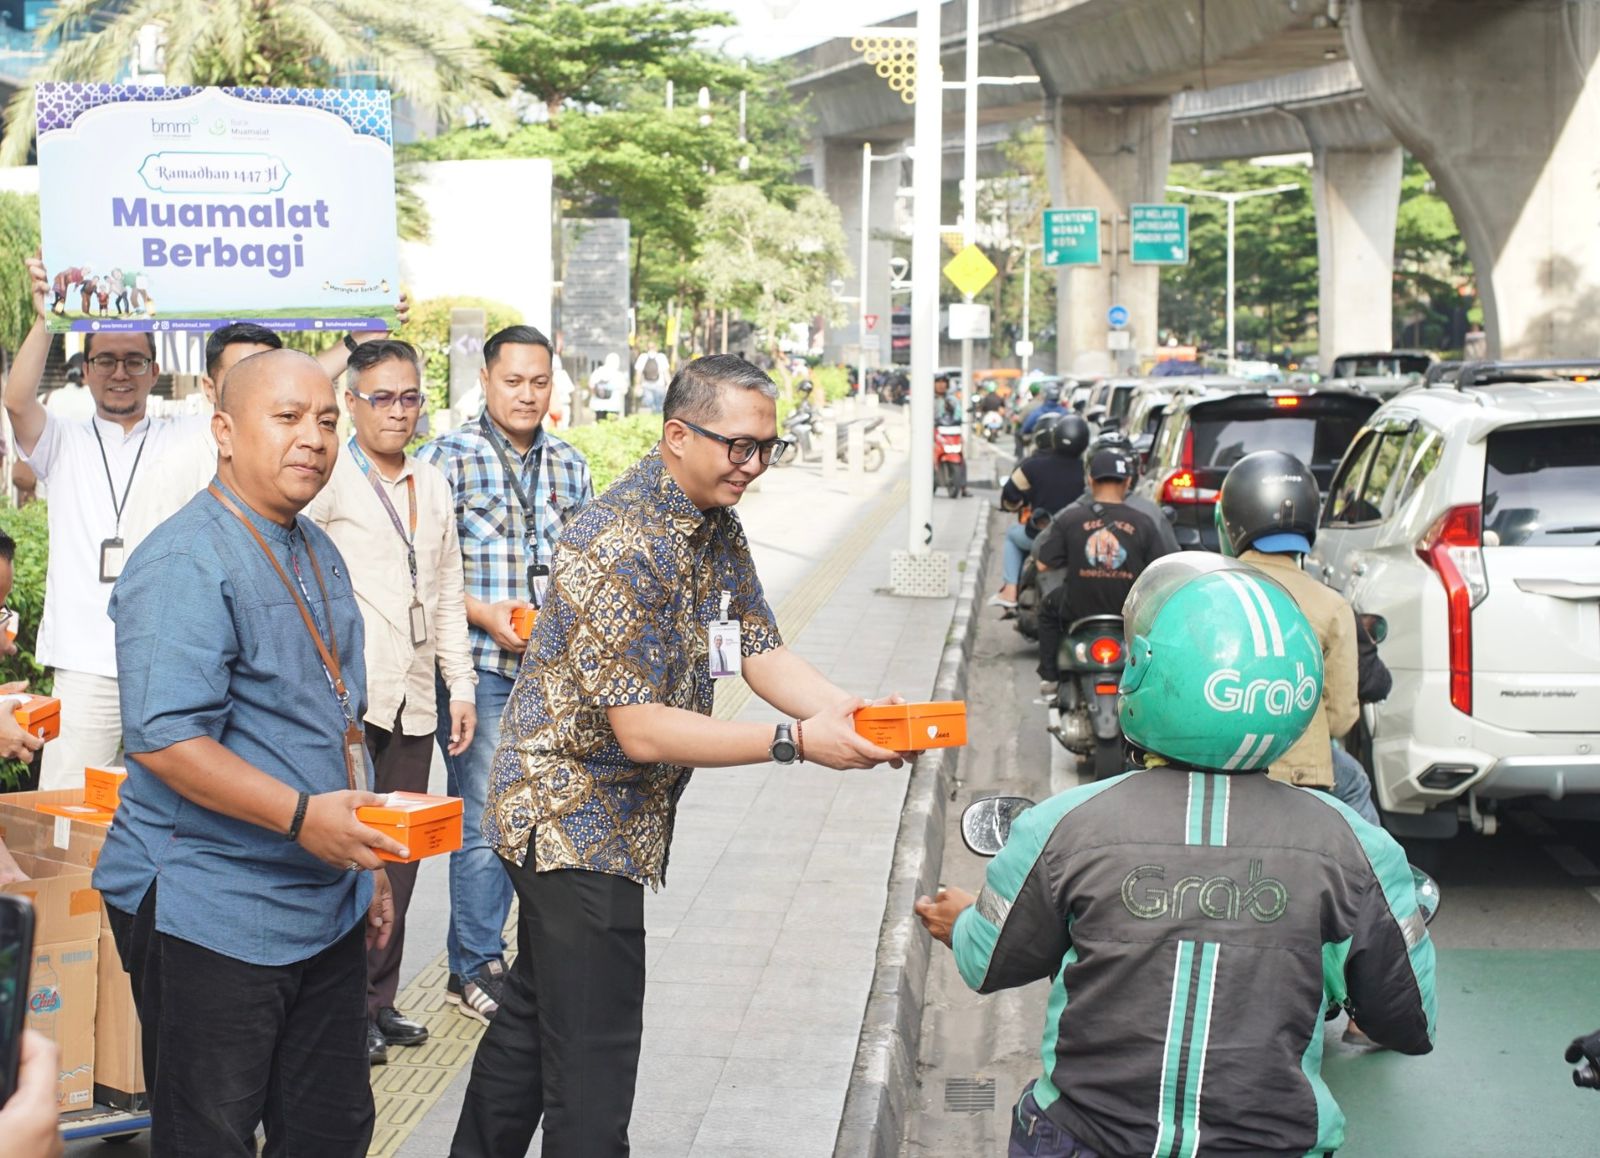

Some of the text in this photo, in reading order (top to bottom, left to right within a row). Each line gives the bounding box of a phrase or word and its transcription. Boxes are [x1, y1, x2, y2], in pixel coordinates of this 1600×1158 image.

[151, 118, 191, 133] bmm
[231, 128, 270, 136] Muamalat
[156, 165, 229, 181] Ramadhan
[234, 170, 262, 183] 1447
[112, 197, 329, 228] Muamalat
[142, 234, 304, 278] Berbagi
[1203, 662, 1317, 715] Grab
[1121, 858, 1288, 923] Grab
